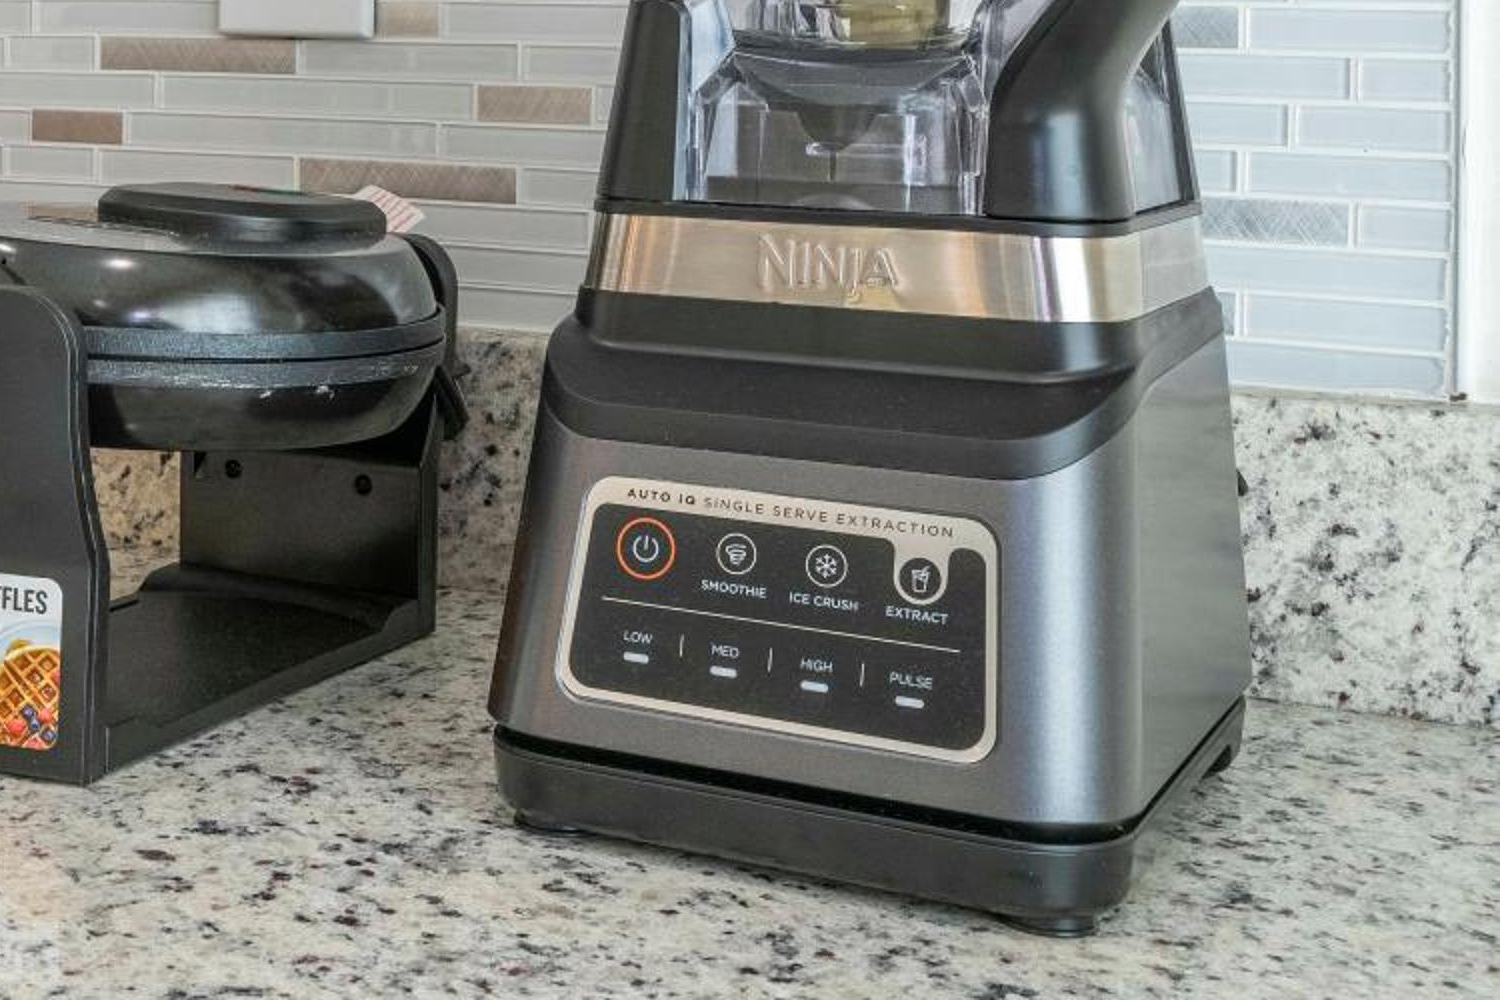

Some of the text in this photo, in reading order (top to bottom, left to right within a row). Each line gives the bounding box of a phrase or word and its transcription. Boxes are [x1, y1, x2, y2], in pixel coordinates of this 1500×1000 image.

[757, 231, 905, 304] NINJA
[627, 487, 954, 537] AUTO IQ SINGLE SERVE EXTRACTION
[701, 579, 767, 599] SMOOTHIE
[789, 591, 859, 612] ICE CRUSH
[885, 605, 949, 625] EXTRACT
[623, 629, 653, 645] LOW
[711, 643, 739, 659] MED
[801, 658, 833, 674] HIGH
[889, 671, 933, 692] PULSE
